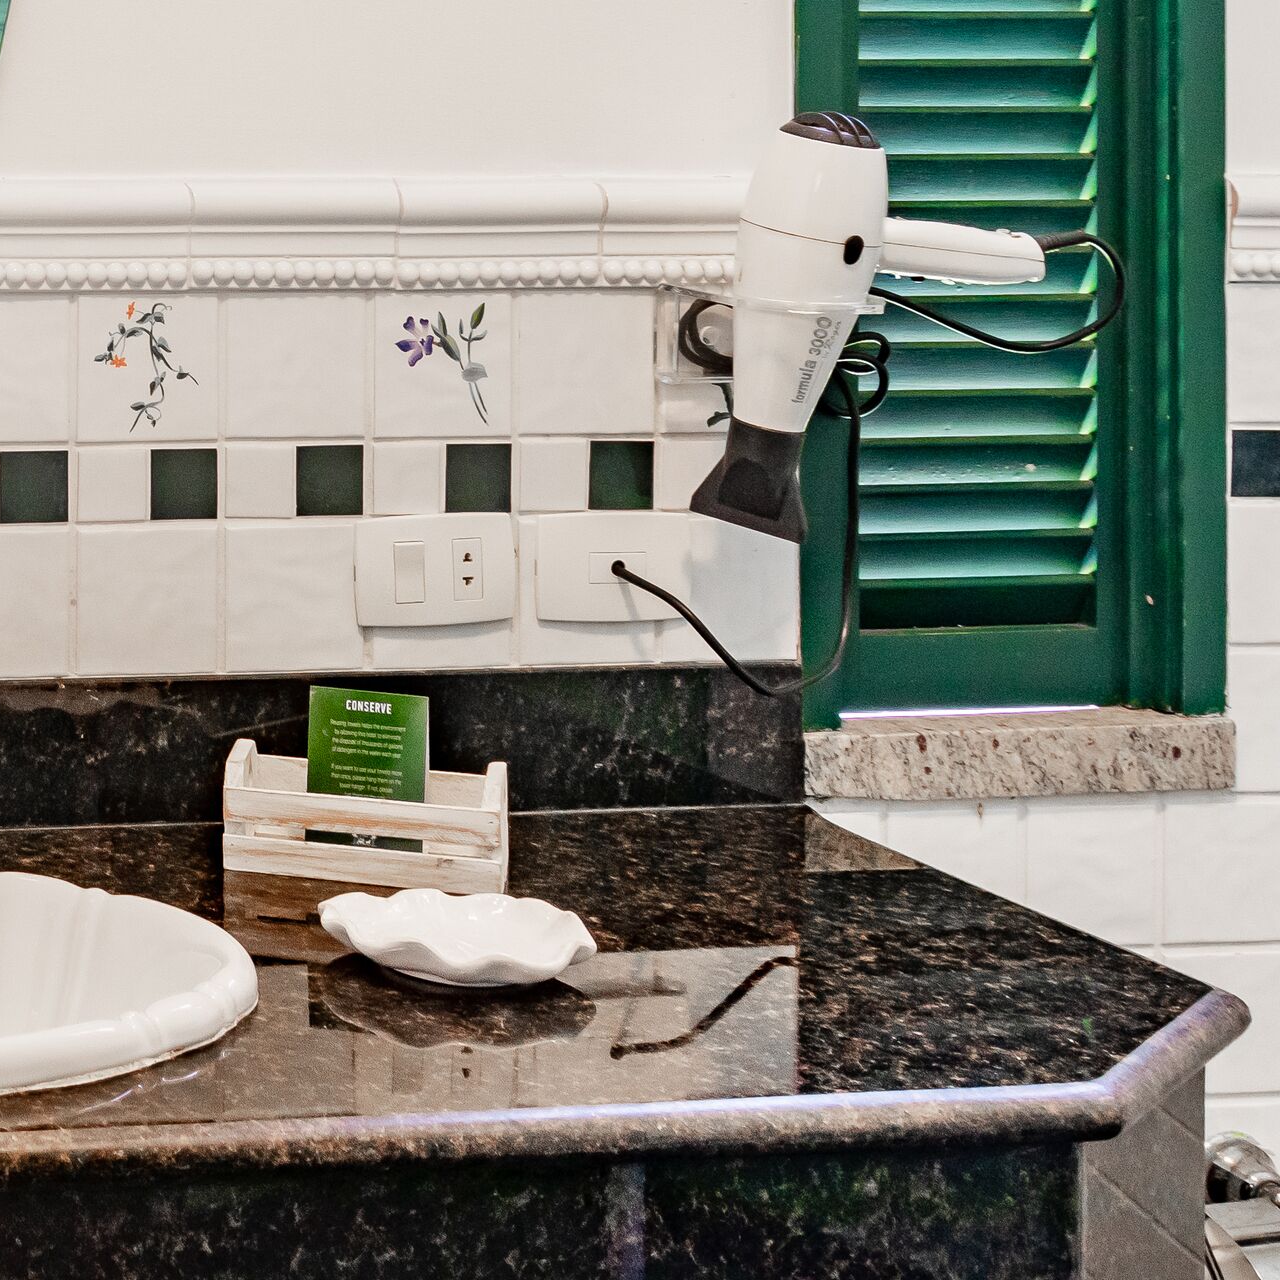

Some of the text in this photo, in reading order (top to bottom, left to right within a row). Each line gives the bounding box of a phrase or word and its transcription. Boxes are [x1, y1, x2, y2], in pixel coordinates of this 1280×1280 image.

[791, 316, 833, 404] formula 3000
[345, 699, 392, 715] CONSERVE
